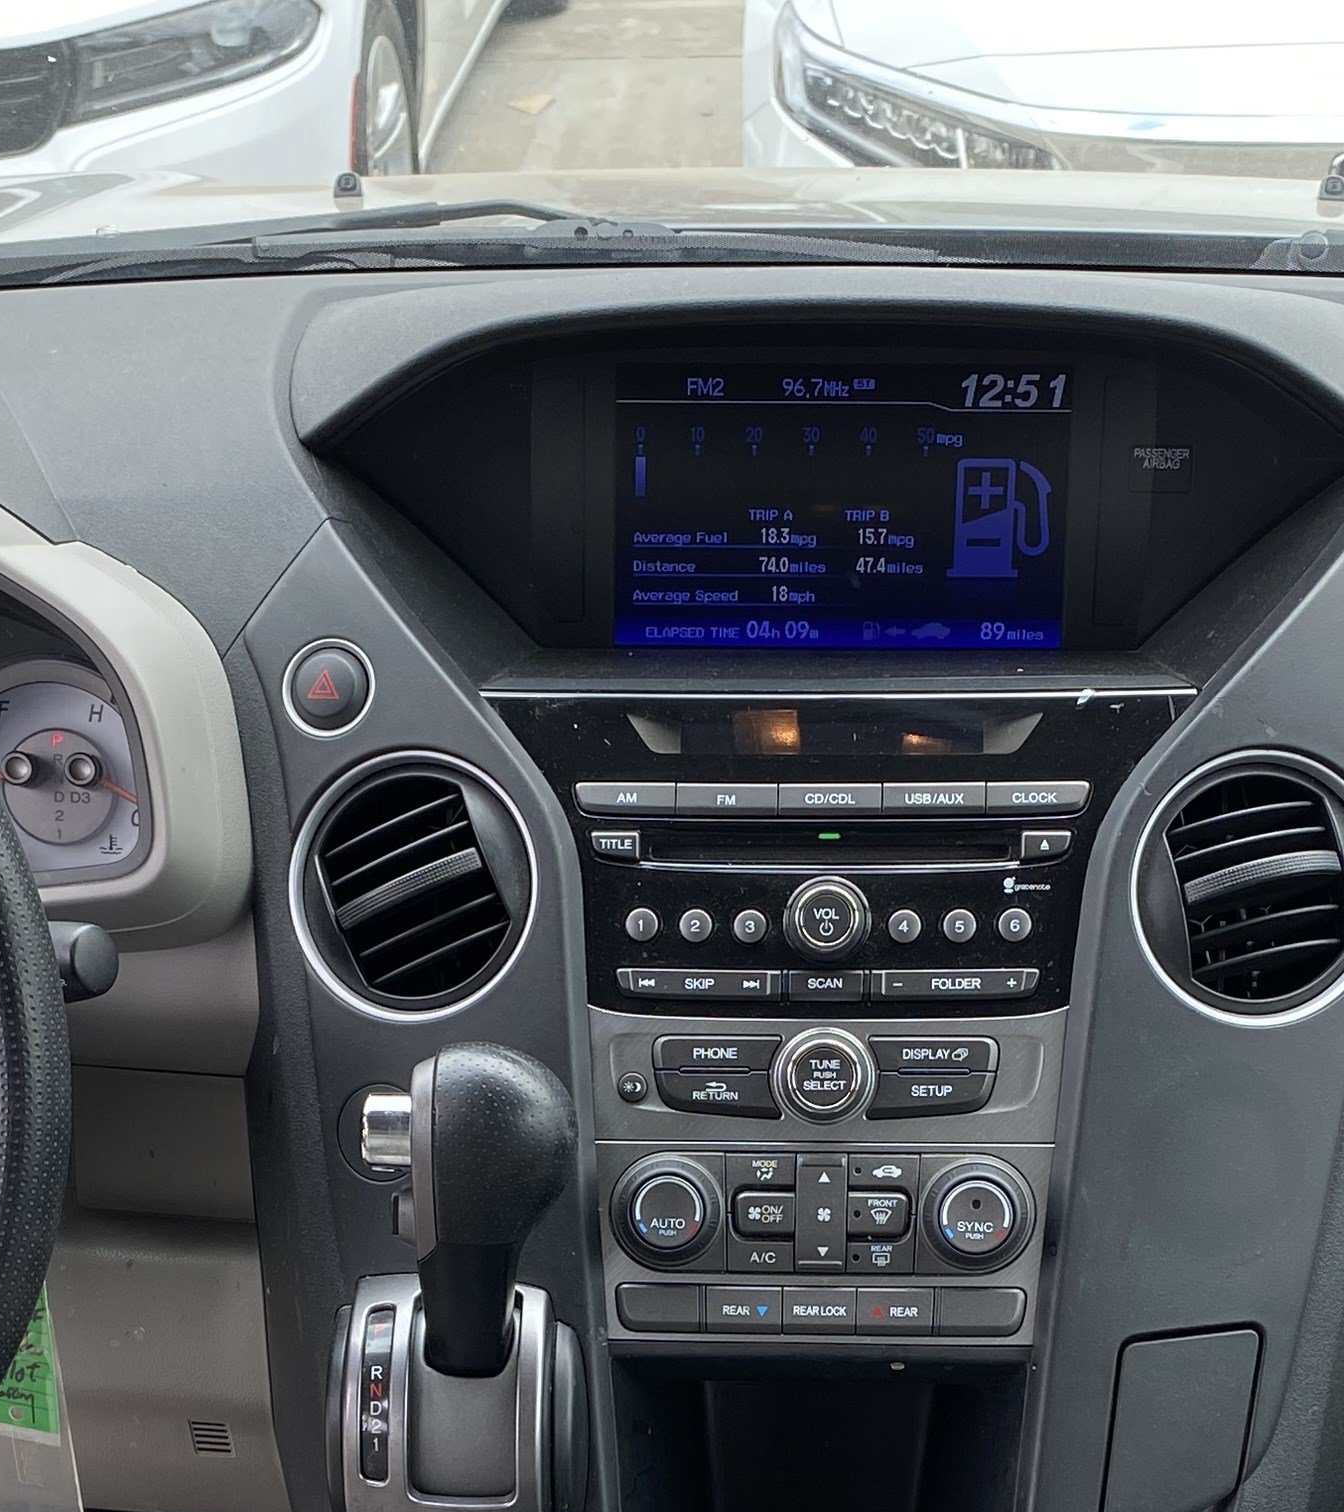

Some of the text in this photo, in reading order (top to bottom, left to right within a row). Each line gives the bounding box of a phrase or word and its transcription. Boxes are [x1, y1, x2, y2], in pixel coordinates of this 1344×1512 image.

[687, 377, 725, 396] FM2
[960, 374, 1067, 408] 12:51
[635, 426, 645, 442] 0
[690, 426, 705, 442] 10
[745, 427, 763, 443] 20
[803, 427, 820, 443] 30
[860, 427, 878, 443] 40
[1133, 448, 1190, 459] PASSENGER
[748, 509, 794, 521] TRIP A
[845, 510, 890, 522] TRIP B
[633, 532, 690, 546] Average
[696, 532, 728, 544] Fuel
[633, 560, 696, 573] Distance
[633, 590, 690, 604] Average
[695, 590, 738, 604] Speed
[645, 627, 704, 638] ELAPSED
[710, 627, 739, 638] TIME
[88, 704, 104, 722] H
[50, 733, 65, 747] P
[53, 754, 64, 765] R
[54, 792, 91, 804] D D3
[616, 793, 637, 804] AM
[717, 795, 736, 806] FM
[804, 793, 856, 806] CD/CDL
[905, 792, 964, 805] USB/AUX
[1012, 792, 1058, 804] CLOCK
[55, 810, 65, 822] 2
[599, 838, 633, 850] TITLE
[813, 908, 840, 921] VOL
[637, 920, 644, 932] 1
[690, 920, 701, 932] 2
[744, 921, 755, 933] 3
[898, 921, 909, 933] 4
[954, 921, 964, 933] 5
[1009, 919, 1020, 932] 6
[684, 977, 715, 990] SKIP
[807, 977, 843, 990] SCAN
[931, 977, 982, 990] FOLDER
[692, 1048, 738, 1059] PHONE
[902, 1048, 951, 1061] DISPLAY
[810, 1059, 840, 1070] TUNE
[813, 1071, 837, 1079] PUSH
[803, 1080, 846, 1091] SELECT
[911, 1085, 953, 1097] SETUP
[692, 1090, 738, 1101] RETURN
[752, 1160, 778, 1168] MODE
[762, 1204, 784, 1214] ON/
[868, 1199, 898, 1208] FRONT
[650, 1217, 686, 1229] AUTO
[762, 1213, 783, 1223] OFF
[658, 1229, 677, 1237] PUSH
[956, 1221, 993, 1233] SYNC
[965, 1232, 984, 1240] PUSH
[750, 1252, 776, 1264] A/C
[722, 1305, 750, 1316] REAR
[793, 1305, 847, 1317] REAR LOCK
[889, 1306, 918, 1318] REAR
[370, 1366, 383, 1380] R
[370, 1383, 382, 1397] N
[370, 1402, 382, 1416] D
[370, 1420, 382, 1434] 2
[373, 1437, 379, 1451] 1
